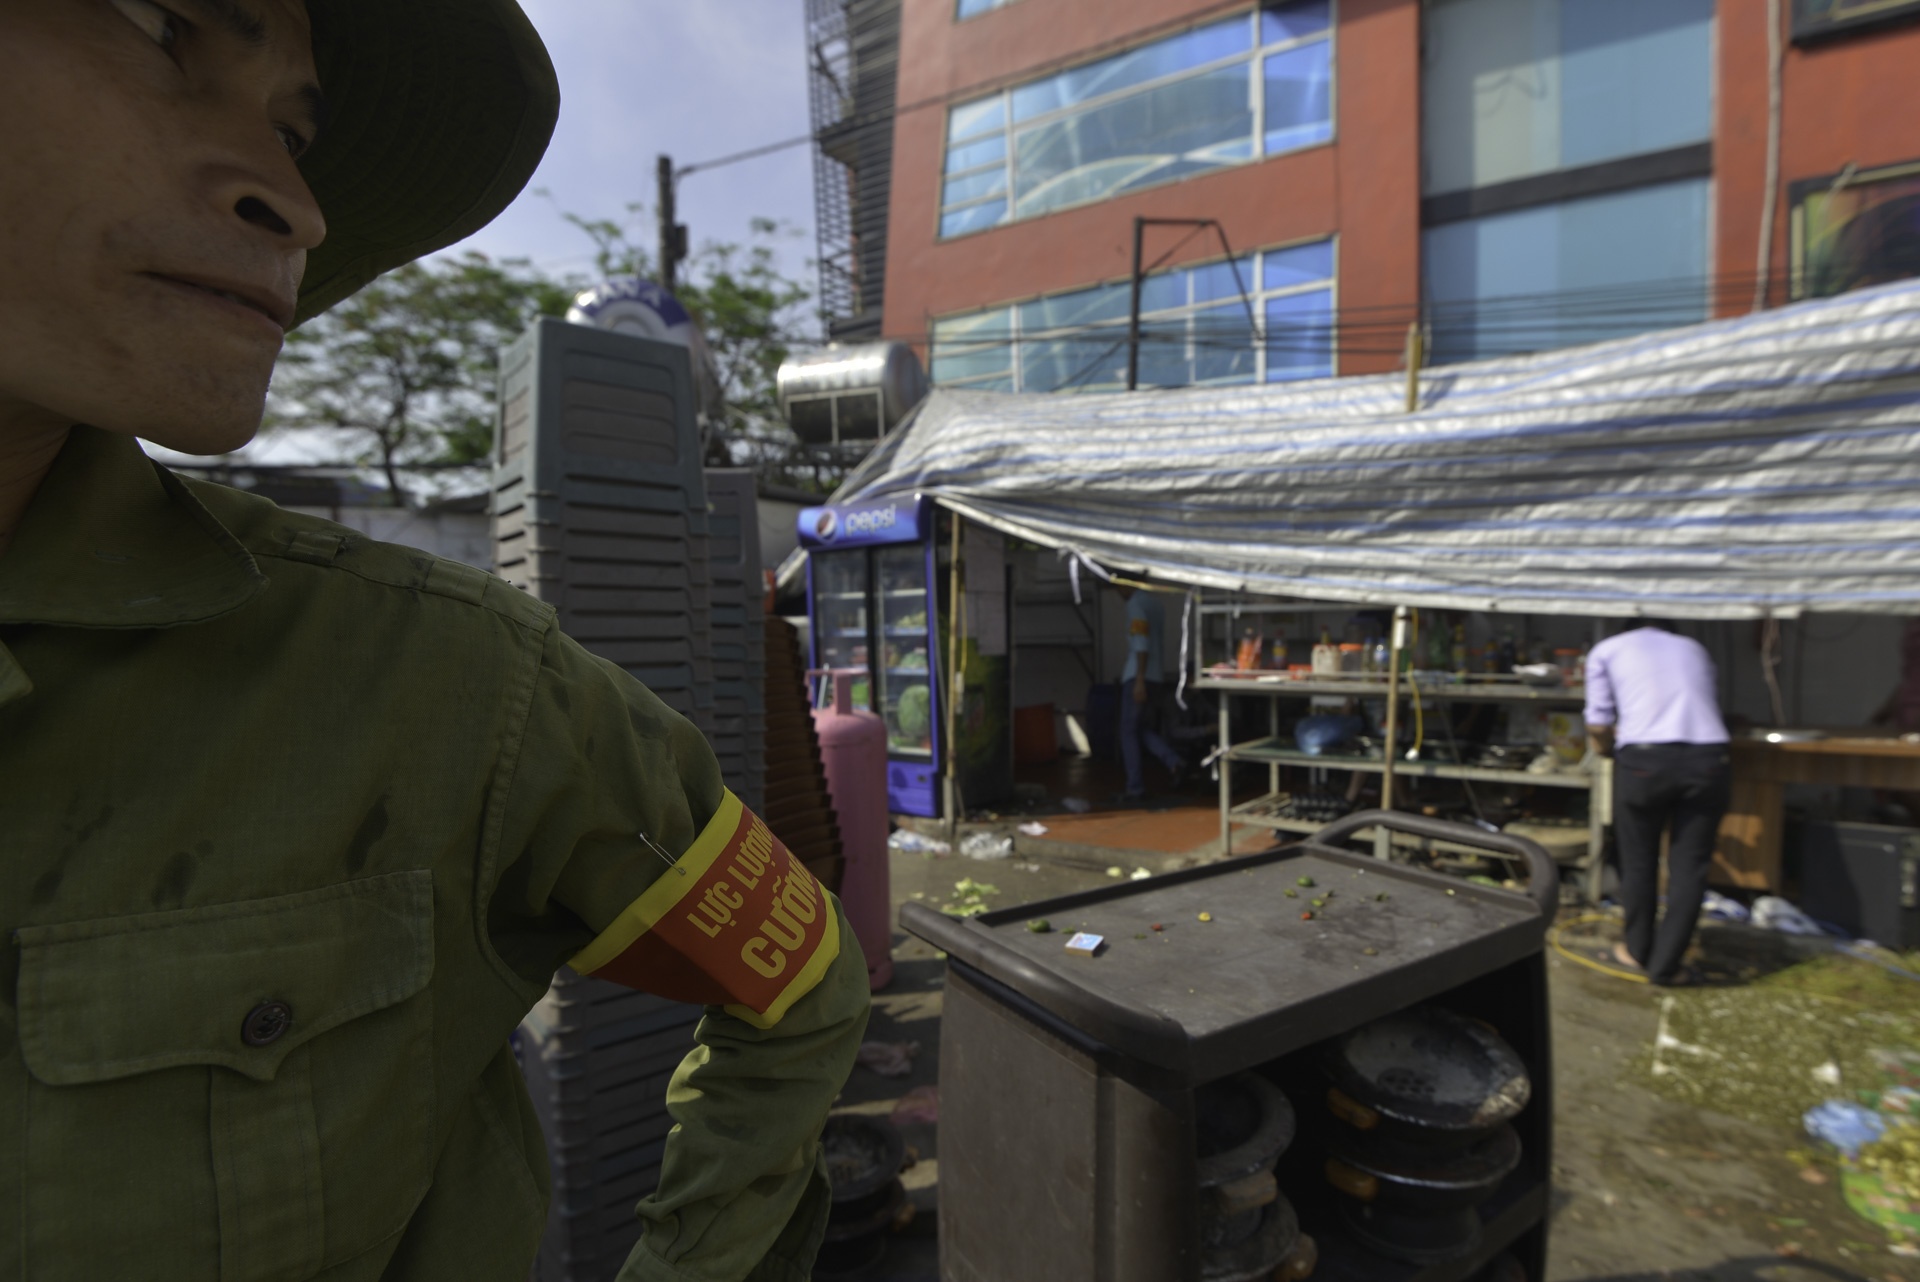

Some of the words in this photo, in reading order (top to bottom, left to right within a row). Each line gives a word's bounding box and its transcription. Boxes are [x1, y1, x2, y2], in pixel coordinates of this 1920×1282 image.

[845, 503, 897, 537] pepsi
[686, 871, 744, 939] LỰC
[726, 814, 776, 891] LƯỢNG
